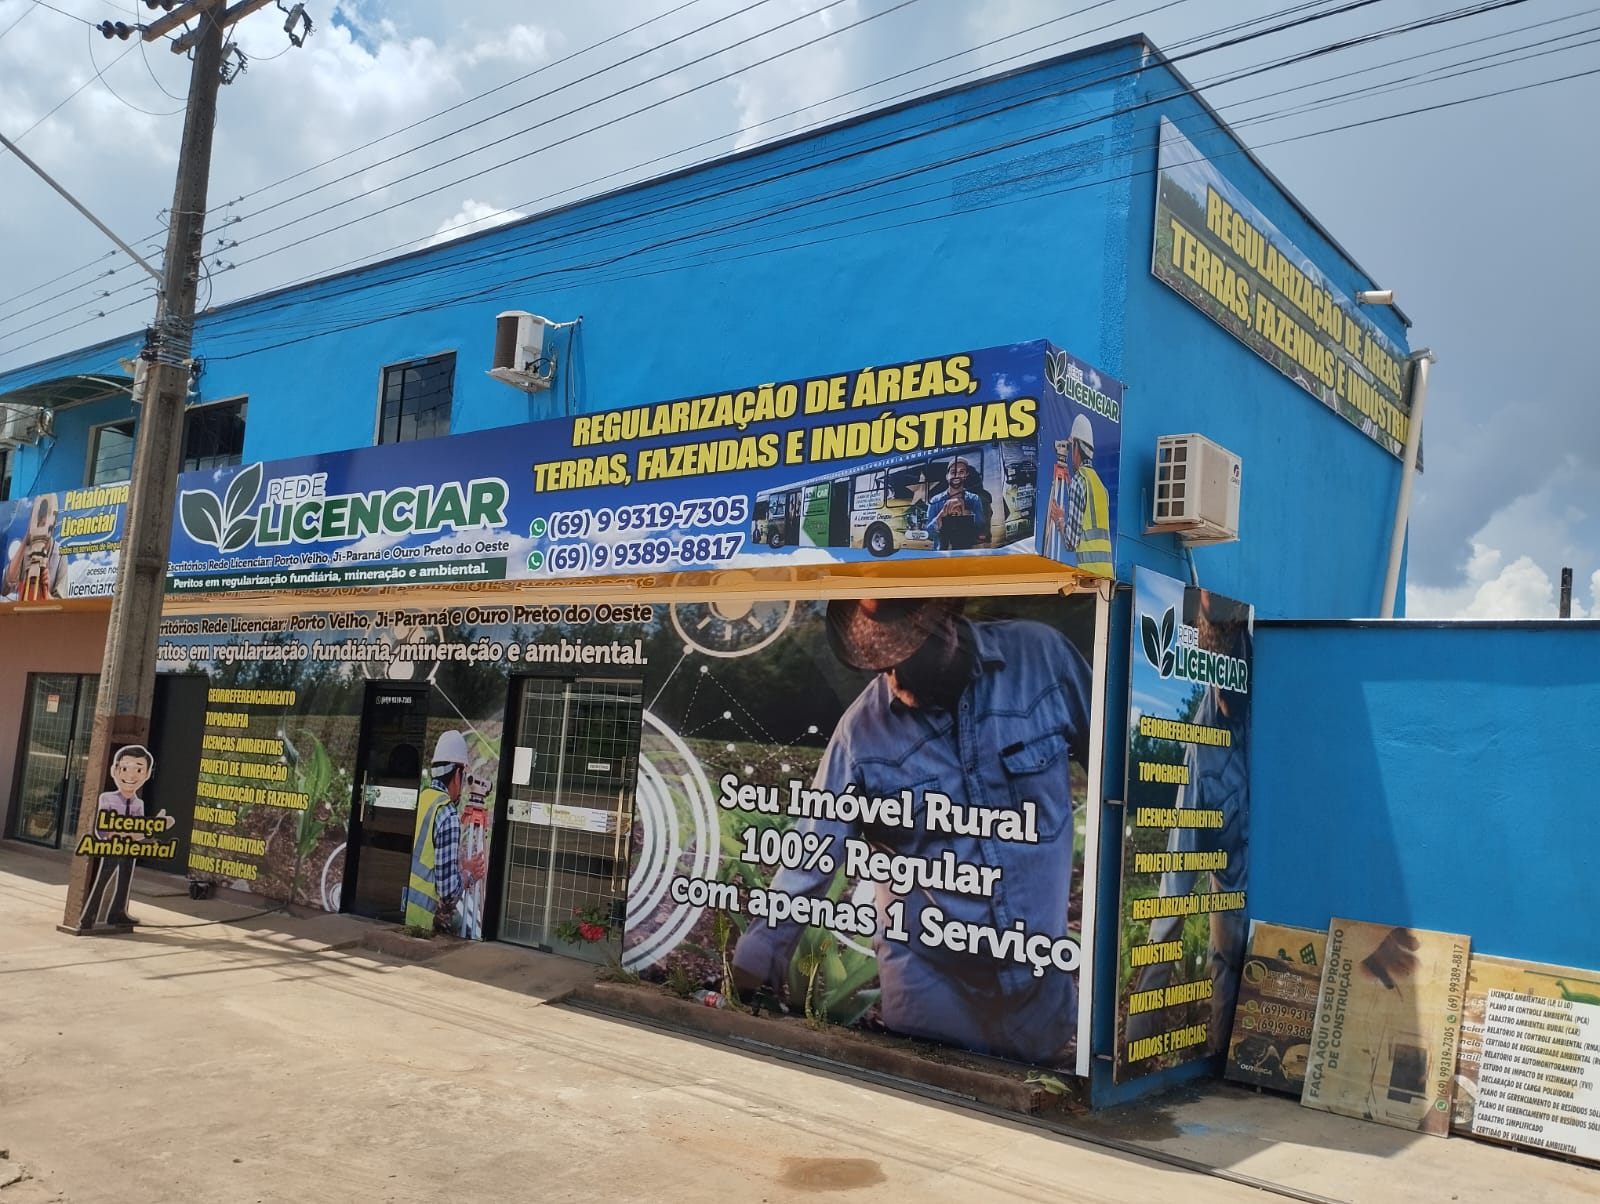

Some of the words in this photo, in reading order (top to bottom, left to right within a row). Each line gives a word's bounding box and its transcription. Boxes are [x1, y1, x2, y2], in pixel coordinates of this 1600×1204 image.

[1207, 185, 1343, 344] REGULARIZAÇÃO
[1345, 314, 1362, 357] DE
[1171, 219, 1252, 329] TERRAS,
[1255, 291, 1335, 391] FAZENDAS
[1337, 359, 1346, 398] E
[571, 383, 798, 447] REGULARIZAÇÃO
[804, 380, 847, 414] DE
[851, 355, 978, 408] ÁREAS,
[1065, 375, 1119, 423] LICENCIAR
[533, 453, 631, 493] TERRAS,
[637, 433, 779, 482] FAZENDAS
[785, 429, 804, 464] E
[810, 399, 1037, 462] INDÚSTRIAS
[64, 485, 129, 511] Plataforma
[268, 474, 327, 503] REDE
[60, 512, 116, 537] Licenciar
[257, 480, 507, 544] LICENCIAR
[549, 513, 590, 538] (69)
[598, 510, 611, 533] 9
[617, 498, 745, 531] 9319-7305
[208, 559, 229, 570] Rede
[274, 554, 299, 566] Porto
[300, 552, 331, 564] Velho,
[333, 549, 381, 562] Ji-Paraná
[383, 550, 390, 559] e
[393, 547, 421, 559] Ouro
[424, 545, 453, 557] Preto
[456, 542, 471, 554] do
[474, 540, 510, 552] Oeste
[547, 546, 587, 572] (69)
[594, 545, 608, 568] 9
[614, 535, 742, 567] 9389-8817
[86, 566, 106, 576] acesse
[173, 578, 203, 589] Peritos
[205, 578, 219, 587] em
[222, 574, 288, 589] regularização
[289, 570, 341, 584] fundiária,
[344, 567, 406, 582] mineração
[408, 568, 416, 578] e
[419, 562, 489, 577] ambiental.
[160, 621, 199, 635] ritórios
[201, 618, 227, 634] Rede
[290, 614, 326, 631] Porto
[329, 611, 371, 630] Velho,
[375, 608, 447, 627] Ji-Paraná
[452, 611, 461, 625] e
[465, 607, 509, 624] Ouro
[514, 605, 561, 623] Preto
[564, 604, 591, 622] do
[596, 603, 653, 622] Oeste
[1178, 626, 1199, 648] REDE
[158, 642, 187, 661] ritos
[189, 644, 210, 661] em
[213, 640, 308, 665] regularização
[312, 638, 395, 663] fundiária,
[399, 637, 503, 667] mineração
[507, 642, 520, 662] e
[525, 638, 649, 665] ambiental.
[1174, 644, 1248, 694] LICENCIAR
[208, 688, 296, 706] GEORREFERENCIAMENTO
[205, 711, 249, 728] TOPOGRAFIA
[1140, 716, 1231, 747] GEORREFERENCIAMENTO
[203, 735, 235, 753] LICENÇAS
[236, 737, 284, 756] AMBIENTAIS
[200, 758, 228, 776] PROJETO
[229, 762, 240, 776] DE
[241, 763, 287, 782] MINERAÇÃO
[1139, 762, 1189, 785] TOPOGRAFIA
[197, 782, 254, 804] REGULARIZAÇÃO
[256, 789, 266, 805] DE
[267, 790, 309, 810] FAZENDAS
[719, 773, 779, 813] Seu
[788, 780, 912, 828] Imóvel
[925, 791, 1038, 843] Rural
[98, 811, 165, 835] Licença
[194, 805, 236, 825] INDÚSTRIAS
[1136, 807, 1177, 831] LICENÇAS
[1178, 808, 1223, 829] AMBIENTAIS
[78, 837, 177, 858] Ambiental
[191, 829, 217, 849] MULTAS
[217, 834, 266, 856] AMBIENTAIS
[188, 853, 215, 874] LAUDOS
[215, 859, 221, 875] E
[221, 860, 257, 881] PERÍCIAS
[740, 827, 835, 873] 100%
[845, 840, 1001, 897] Regular
[1135, 853, 1171, 873] PROJETO
[1172, 853, 1183, 872] DE
[1184, 849, 1228, 873] MINERAÇÃO
[1133, 893, 1199, 920] REGULARIZAÇÃO
[1200, 894, 1210, 912] DE
[1211, 892, 1245, 912] FAZENDAS
[671, 876, 740, 912] com
[748, 888, 877, 936] apenas
[886, 901, 909, 941] 1
[920, 908, 1080, 977] Serviço
[1131, 940, 1183, 968] INDÚSTRIAS
[1327, 929, 1344, 985] PROJETO
[1449, 944, 1465, 993] 99389-8817
[1129, 988, 1163, 1015] MULTAS
[1164, 979, 1213, 1007] AMBIENTAIS
[1323, 986, 1335, 1012] SEU
[1331, 959, 1353, 1049] CONSTRUÇÃO!
[1447, 993, 1460, 1013] (69)
[1491, 990, 1514, 1000] LICENÇAS
[1515, 994, 1546, 1005] AMBIENTAIS
[1322, 1013, 1331, 1023] O
[1488, 1014, 1514, 1024] CADASTRO
[1516, 1018, 1545, 1030] AMBIENTAL
[1547, 1024, 1564, 1033] RURAL
[1489, 1002, 1506, 1011] PLANO
[1516, 1006, 1541, 1017] CONTROLE
[1543, 1010, 1573, 1022] AMBIENTAL
[1128, 1038, 1163, 1063] LAUDOS
[1164, 1034, 1170, 1052] E
[1170, 1024, 1207, 1051] PERÍCIAS
[1317, 1029, 1330, 1061] AQUI
[1440, 1027, 1456, 1076] 99319-7305
[1520, 1044, 1558, 1057] REGULARIDADE
[1560, 1051, 1590, 1063] AMBIENTAL
[1524, 1032, 1551, 1043] CONTROLE
[1552, 1037, 1582, 1049] AMBIENTAL
[1328, 1052, 1340, 1070] DE
[1483, 1063, 1502, 1072] ESTUDO
[1511, 1067, 1535, 1078] IMPACTO
[1521, 1057, 1584, 1075] AUTOMONITORAMENTO
[1310, 1062, 1326, 1098] FAÇA
[1437, 1077, 1449, 1097] (69)
[1523, 1082, 1541, 1092] CARGA
[1543, 1086, 1574, 1099] POLUIDORA
[1480, 1087, 1498, 1097] PLANO
[1507, 1092, 1551, 1108] GERENCIAMENTO
[1477, 1113, 1504, 1125] CADASTRO
[1506, 1118, 1543, 1133] SIMPLIFICADO
[1511, 1132, 1544, 1147] VIABILIDADE
[1546, 1139, 1577, 1153] AMBIENTAL
